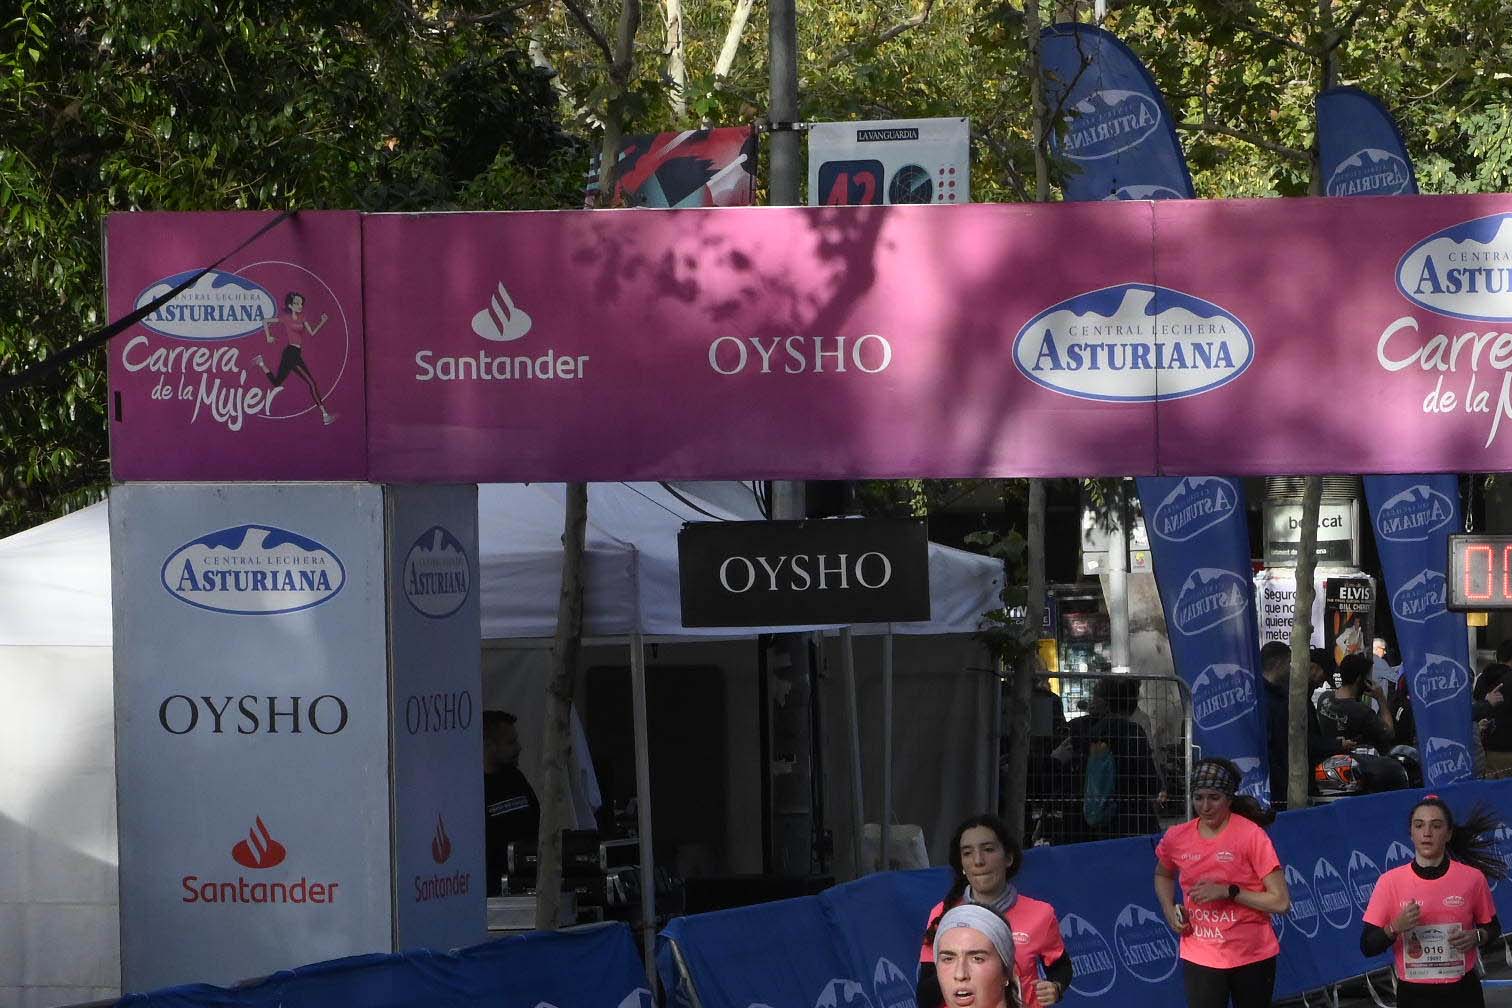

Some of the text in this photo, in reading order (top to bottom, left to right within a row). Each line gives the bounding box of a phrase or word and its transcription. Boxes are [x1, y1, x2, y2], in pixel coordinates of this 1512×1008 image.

[1069, 324, 1227, 337] CENTRAL LECHERA
[122, 335, 242, 373] Carrera
[415, 349, 589, 381] Santander
[708, 334, 892, 376] OYSHO
[1032, 328, 1235, 372] ASTURIANA
[151, 370, 284, 431] de la Mujer
[1423, 375, 1458, 414] de
[1465, 372, 1490, 413] la
[176, 558, 332, 592] ASTURIANA
[203, 556, 326, 565] CENTRAL LECHERA
[719, 552, 892, 593] OYSHO
[408, 562, 467, 596] ASTURIANA
[1340, 587, 1370, 600] ELVIS
[1265, 604, 1281, 615] que
[159, 694, 349, 734] OYSHO
[406, 690, 473, 735] OYSHO
[182, 876, 339, 903] Santander
[414, 870, 470, 902] Santander
[1195, 925, 1223, 939] UMA
[1424, 946, 1443, 954] 016
